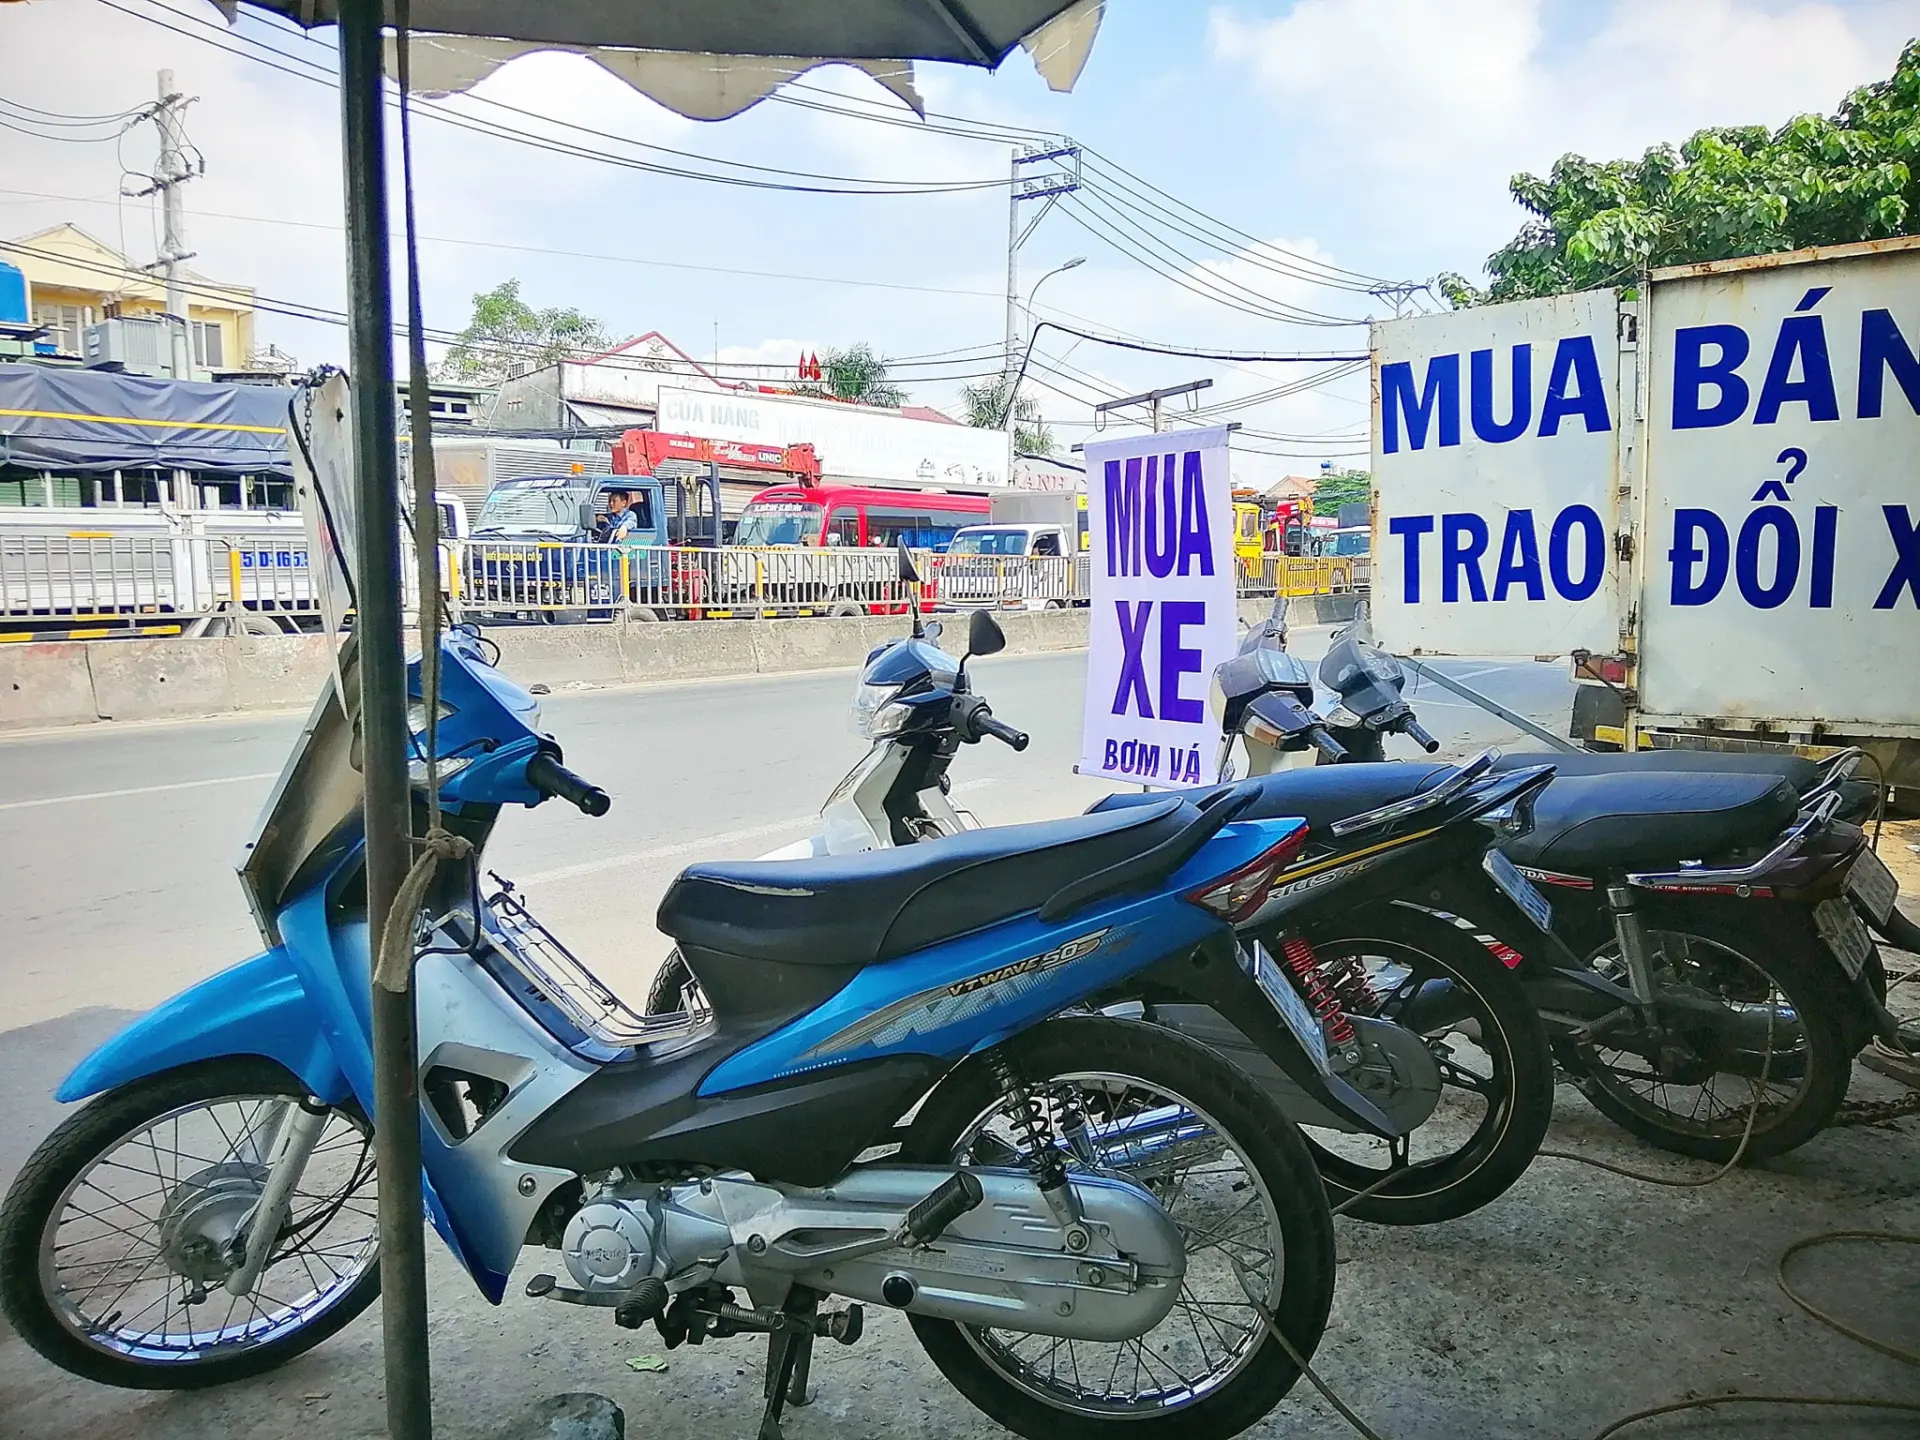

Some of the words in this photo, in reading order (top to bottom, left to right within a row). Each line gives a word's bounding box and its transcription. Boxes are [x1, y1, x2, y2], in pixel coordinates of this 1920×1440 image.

[1380, 335, 1613, 454] MUA
[1671, 286, 1920, 430] BÁN
[757, 451, 783, 464] UNIC
[1104, 450, 1215, 578] MUA
[1389, 504, 1606, 605] TRAO
[1667, 447, 1839, 610] ĐỔI
[1111, 600, 1206, 724] XE
[1102, 738, 1160, 777] BƠM
[1169, 742, 1200, 784] VÁ
